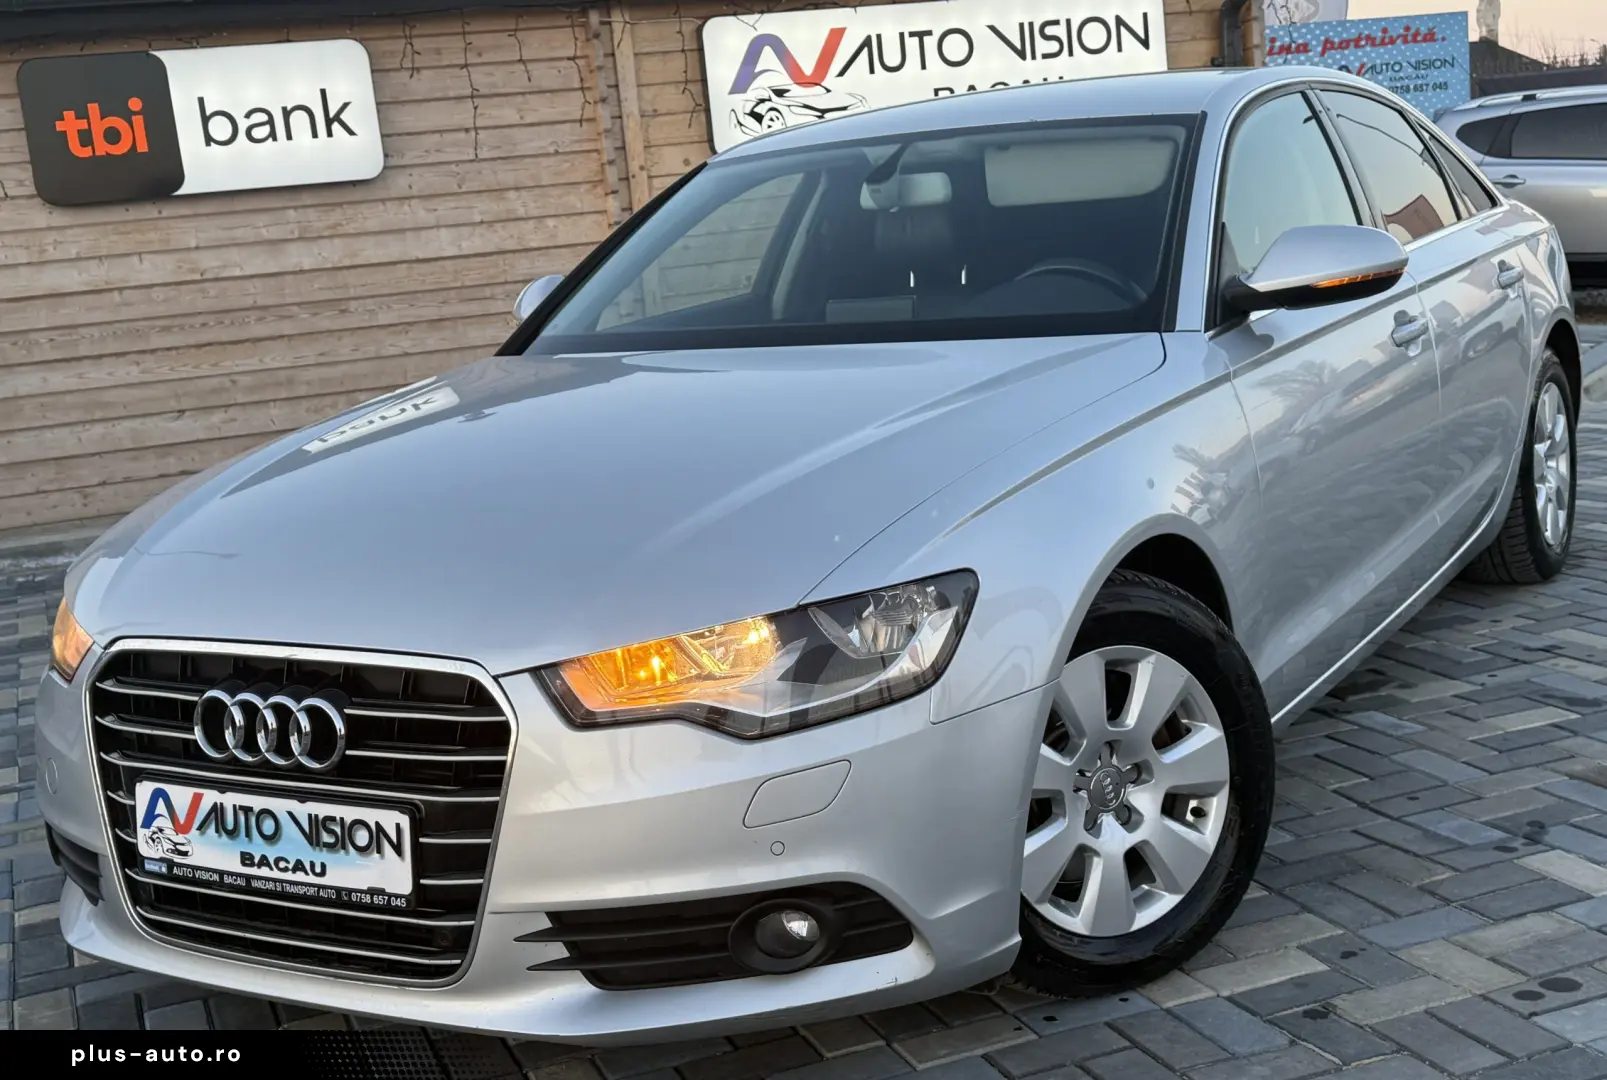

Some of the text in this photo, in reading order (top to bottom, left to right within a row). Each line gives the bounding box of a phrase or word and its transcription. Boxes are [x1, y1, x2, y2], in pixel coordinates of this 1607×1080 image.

[835, 12, 1150, 78] AUTO VISION
[1363, 61, 1403, 75] AUTO
[1406, 56, 1455, 71] VISION
[1413, 84, 1429, 93] 657
[1432, 82, 1449, 91] 045
[56, 88, 358, 158] tbi bank
[196, 802, 402, 858] AUTO VISION
[239, 851, 327, 878] BACAU
[172, 866, 193, 877] AUTO
[194, 869, 220, 882] VISION
[223, 874, 246, 887] BACAU
[251, 878, 275, 891] VANZARI
[276, 883, 282, 893] SI
[283, 884, 318, 897] TRANSPORT
[319, 888, 336, 899] AUTO
[351, 892, 371, 904] 0758
[373, 895, 388, 906] 657
[390, 897, 407, 908] 045
